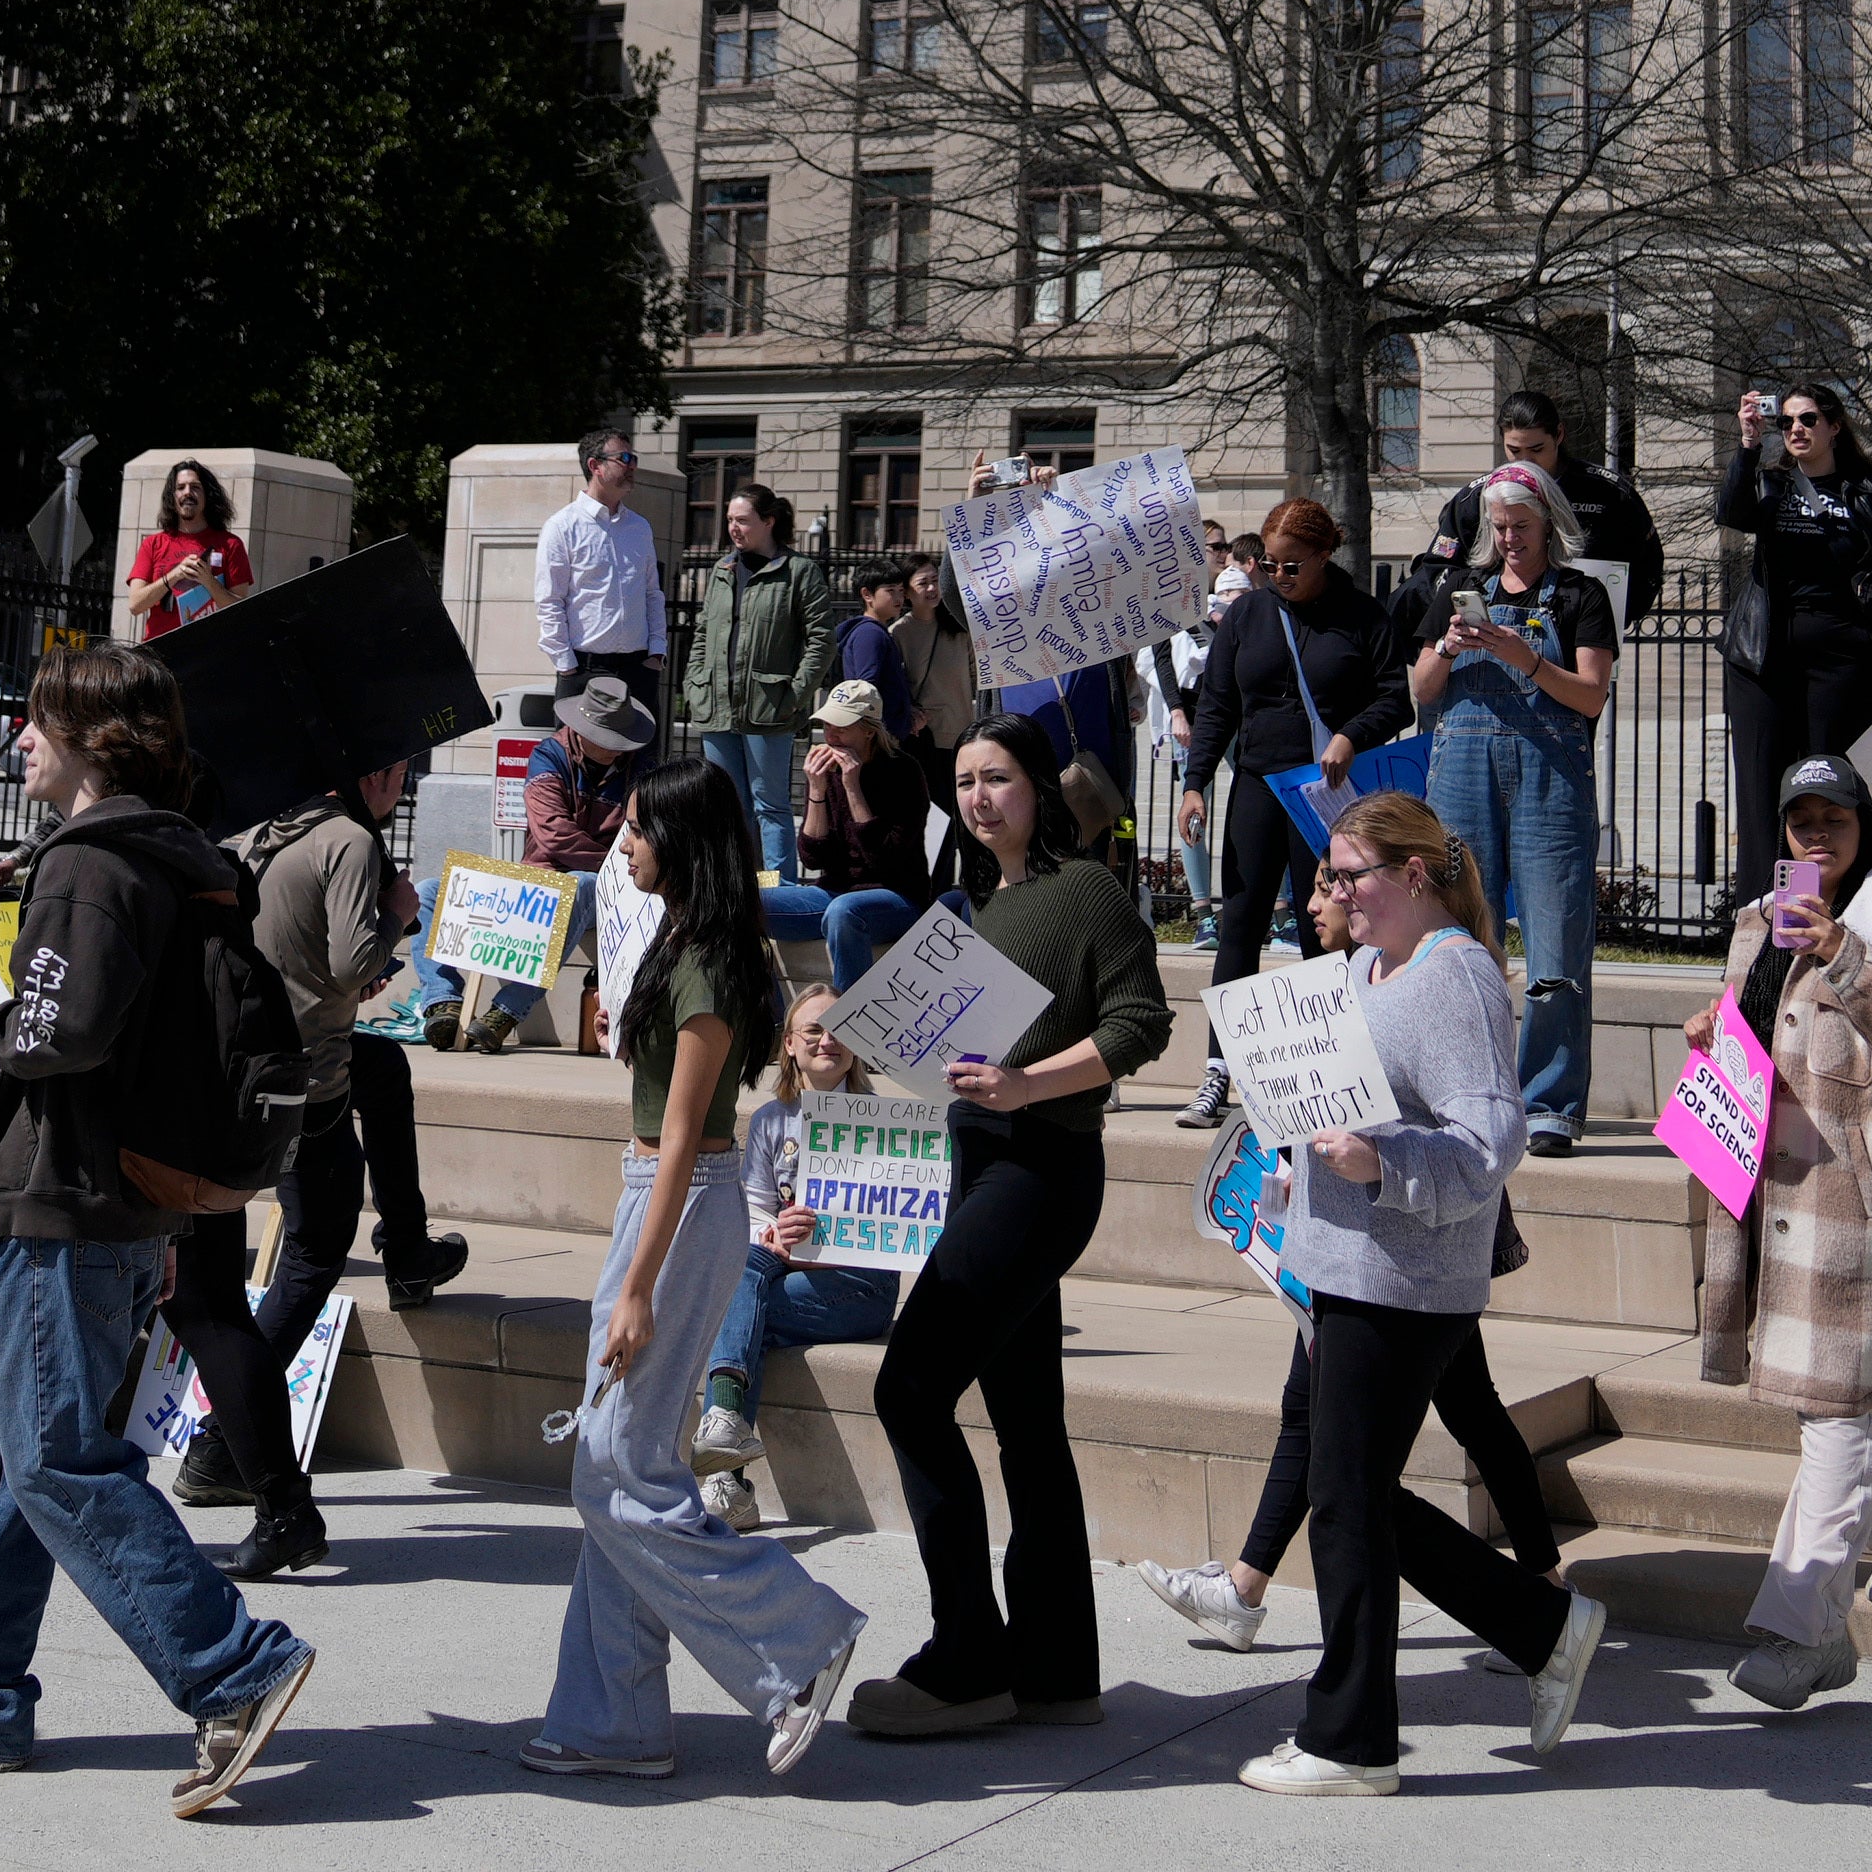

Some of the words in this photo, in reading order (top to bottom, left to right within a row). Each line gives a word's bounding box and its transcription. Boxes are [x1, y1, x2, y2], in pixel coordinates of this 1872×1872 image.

[1100, 461, 1132, 518] justice
[1571, 503, 1604, 515] EXIDE
[955, 505, 974, 550] sexism
[979, 502, 996, 538] trans
[1051, 522, 1104, 612] equity
[1111, 547, 1132, 575] bias
[1139, 491, 1182, 601] inclusion
[961, 584, 997, 632] political
[972, 541, 1028, 654] diversity
[1059, 593, 1089, 644] belonging
[1094, 621, 1113, 655] status
[498, 755, 528, 767] POSITIV
[447, 873, 469, 908] $1
[466, 888, 498, 912] spent
[495, 888, 515, 924] by
[470, 927, 480, 941] in
[484, 934, 547, 956] economic
[470, 942, 543, 980] OUTPUT
[832, 968, 929, 1047] TIME
[913, 918, 975, 974] FOR
[1219, 986, 1266, 1039] Got
[1271, 963, 1354, 1041] Plague?
[885, 978, 979, 1064] REACTION
[872, 1055, 899, 1076] A
[1270, 1046, 1286, 1064] me
[1258, 1074, 1303, 1100] THANK
[1310, 1069, 1323, 1091] A
[1696, 1067, 1739, 1120] STAND
[1740, 1121, 1757, 1141] UP
[817, 1096, 837, 1112] IF
[845, 1098, 880, 1118] YOU
[890, 1103, 941, 1122] CARE
[1267, 1076, 1374, 1140] SCIENTIST!
[1676, 1081, 1707, 1119] FOR
[1707, 1113, 1758, 1177] SCIENCE
[809, 1156, 864, 1179] DON'T
[805, 1178, 949, 1221] OPTIMIZA
[811, 1214, 944, 1256] RESEAR
